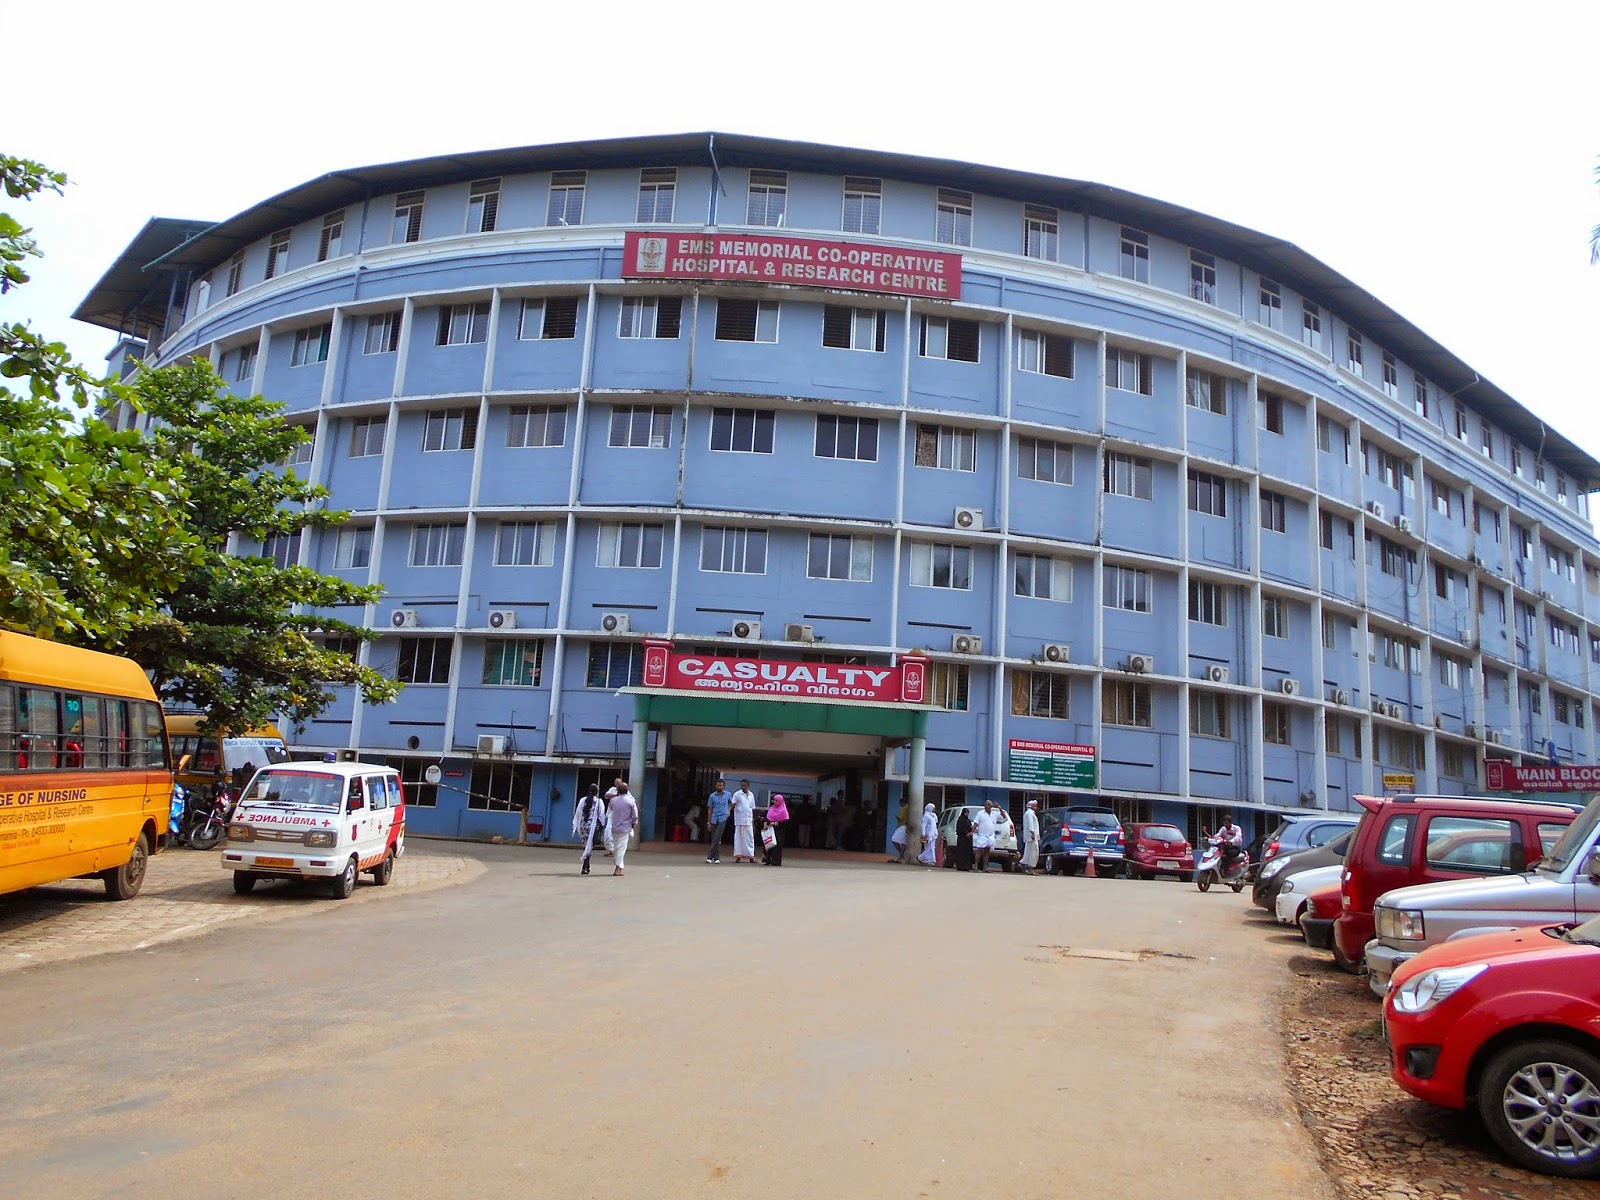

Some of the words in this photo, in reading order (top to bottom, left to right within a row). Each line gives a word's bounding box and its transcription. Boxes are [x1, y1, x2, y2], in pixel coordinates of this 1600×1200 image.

[678, 239, 714, 255] EMS
[719, 240, 813, 261] MEMORIAL
[817, 246, 944, 274] CO-OPERATIVE
[672, 257, 759, 275] HOSPITAL
[763, 261, 776, 276] &
[781, 262, 875, 285] RESEARCH
[879, 271, 948, 293] CENTRE
[677, 658, 891, 687] CASUALTY
[694, 678, 800, 693] അത്യാഹിത
[806, 683, 876, 697] വിഭാഗം
[1071, 745, 1089, 753] HOSPITAL
[1516, 768, 1556, 780] MAIN
[17, 792, 35, 805] OF
[37, 788, 87, 803] NURSING
[23, 807, 47, 824] Hospital
[47, 807, 52, 820] &
[53, 806, 77, 819] Research
[78, 803, 94, 816] Centre
